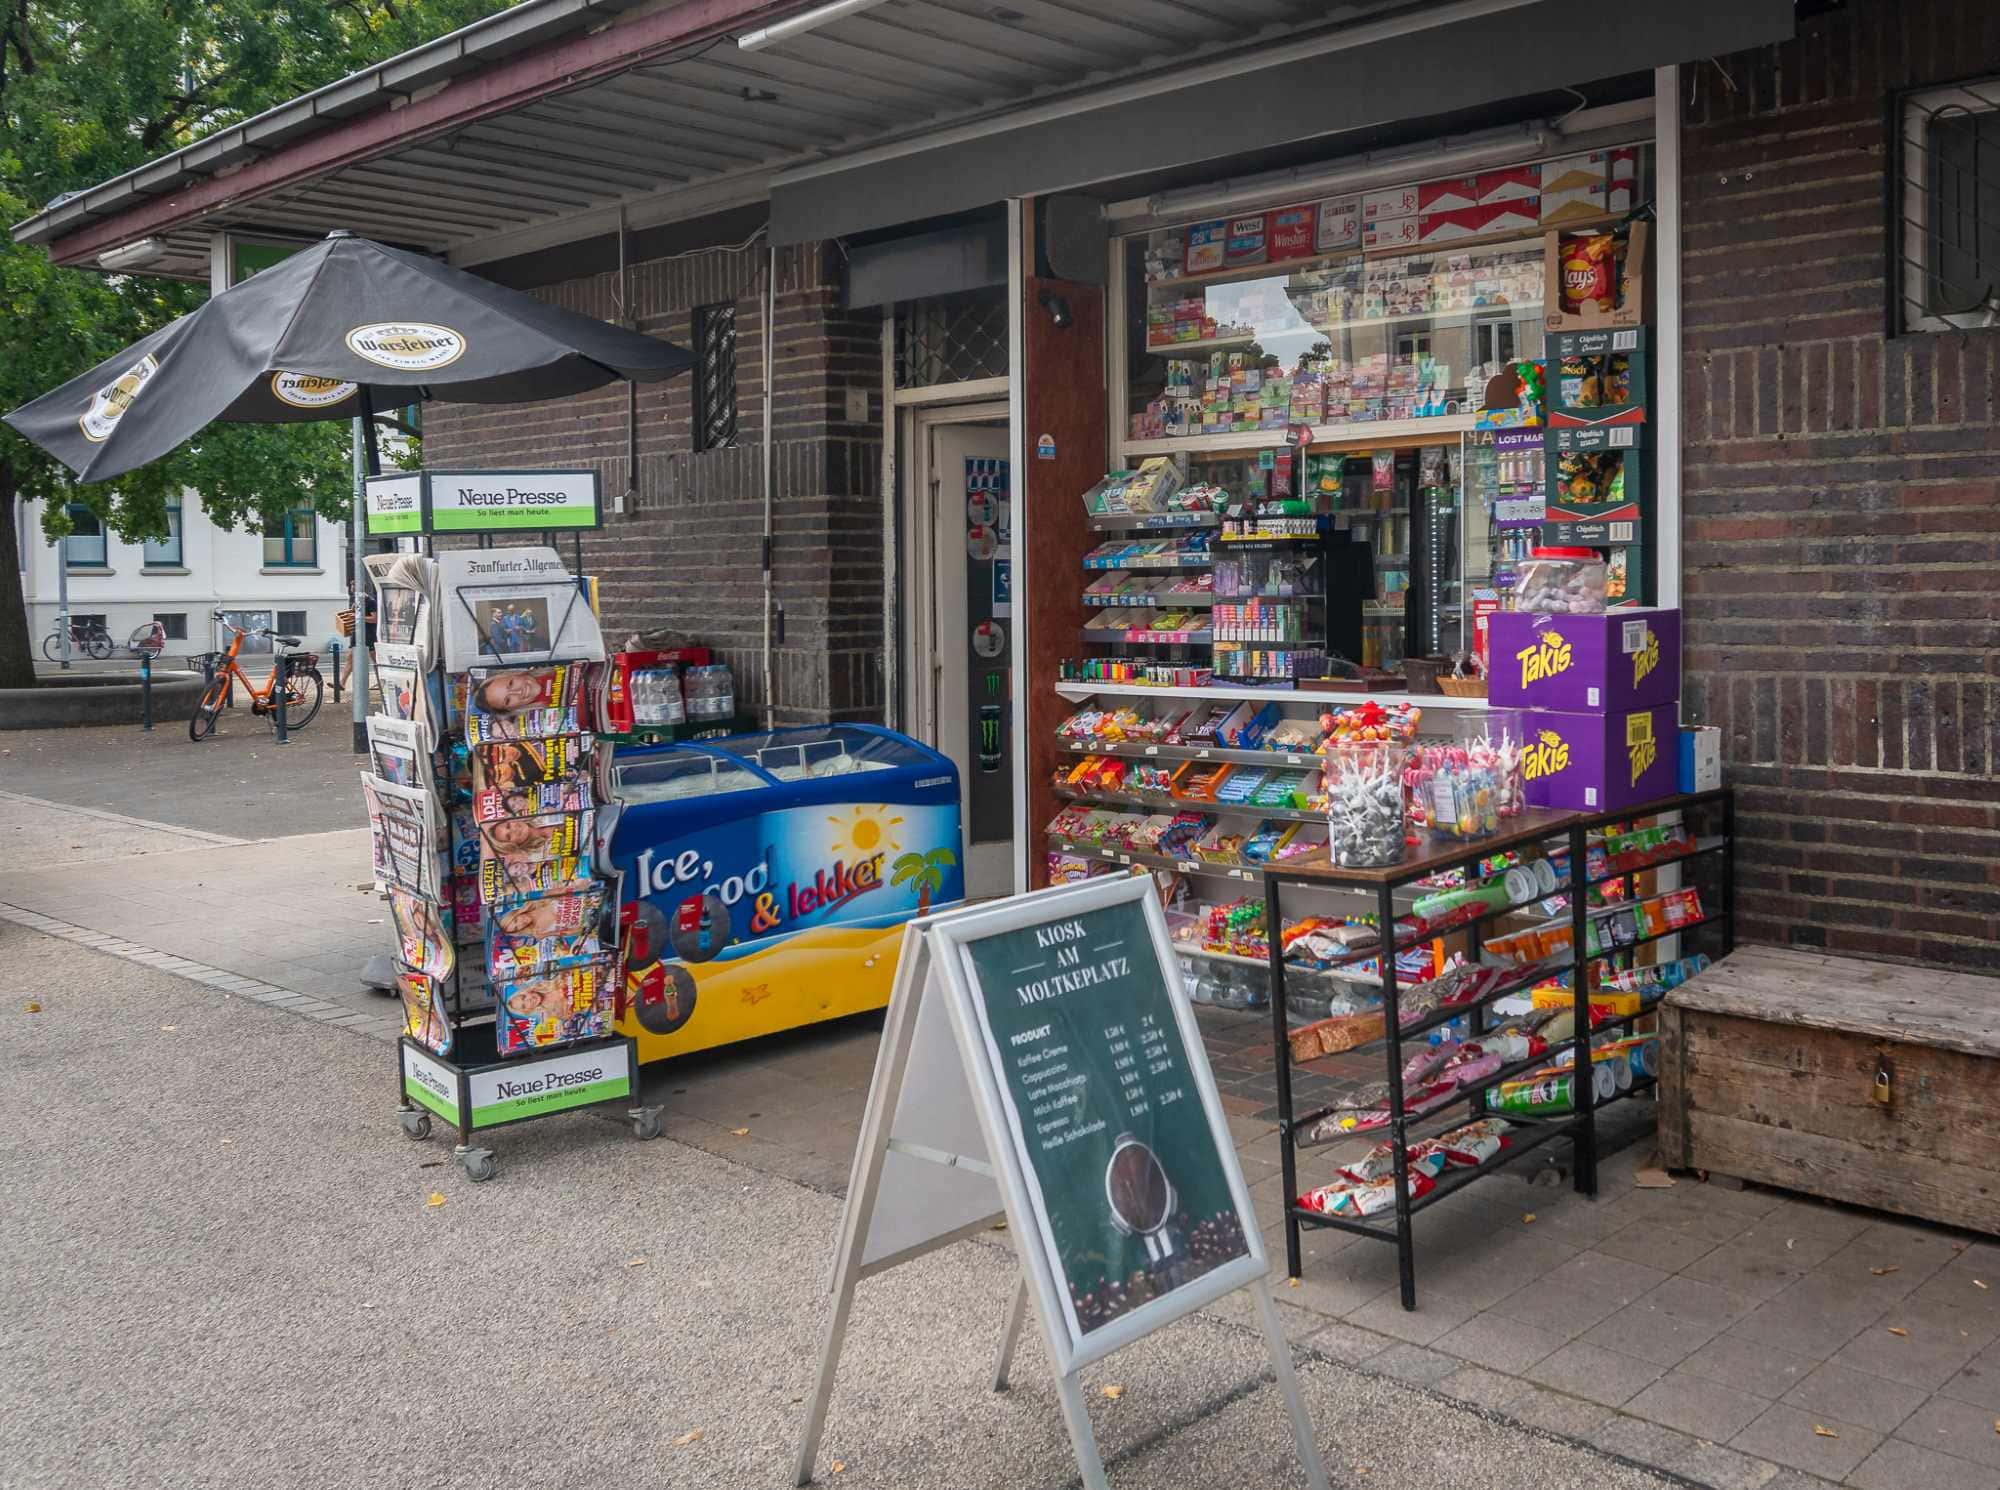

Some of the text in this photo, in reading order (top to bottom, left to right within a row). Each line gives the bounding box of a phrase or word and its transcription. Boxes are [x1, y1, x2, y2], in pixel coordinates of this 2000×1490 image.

[1235, 222, 1261, 233] West
[1274, 230, 1306, 248] Winston
[357, 336, 455, 352] Warsteiner
[1499, 432, 1545, 445] LOST MAR
[458, 488, 567, 506] Neue Presse
[477, 509, 486, 517] So
[488, 508, 505, 517] liest
[468, 558, 522, 574] Frankfurter
[1516, 643, 1574, 690] Takis
[1632, 640, 1659, 690] Takis
[1521, 743, 1569, 780] Takis
[1629, 736, 1657, 788] Takis
[483, 859, 496, 902] FREIZEIT
[637, 849, 713, 898] Ice,
[751, 852, 886, 934] & lekker
[1035, 919, 1087, 948] KIOSK
[1056, 945, 1081, 969] AM
[581, 971, 593, 1008] Filme
[1015, 956, 1131, 1007] MOLTKEPLATZ
[1010, 1024, 1052, 1047] PRODUKT
[496, 1066, 603, 1101] Neue Presse
[516, 1098, 527, 1107] So
[546, 1092, 563, 1102] man
